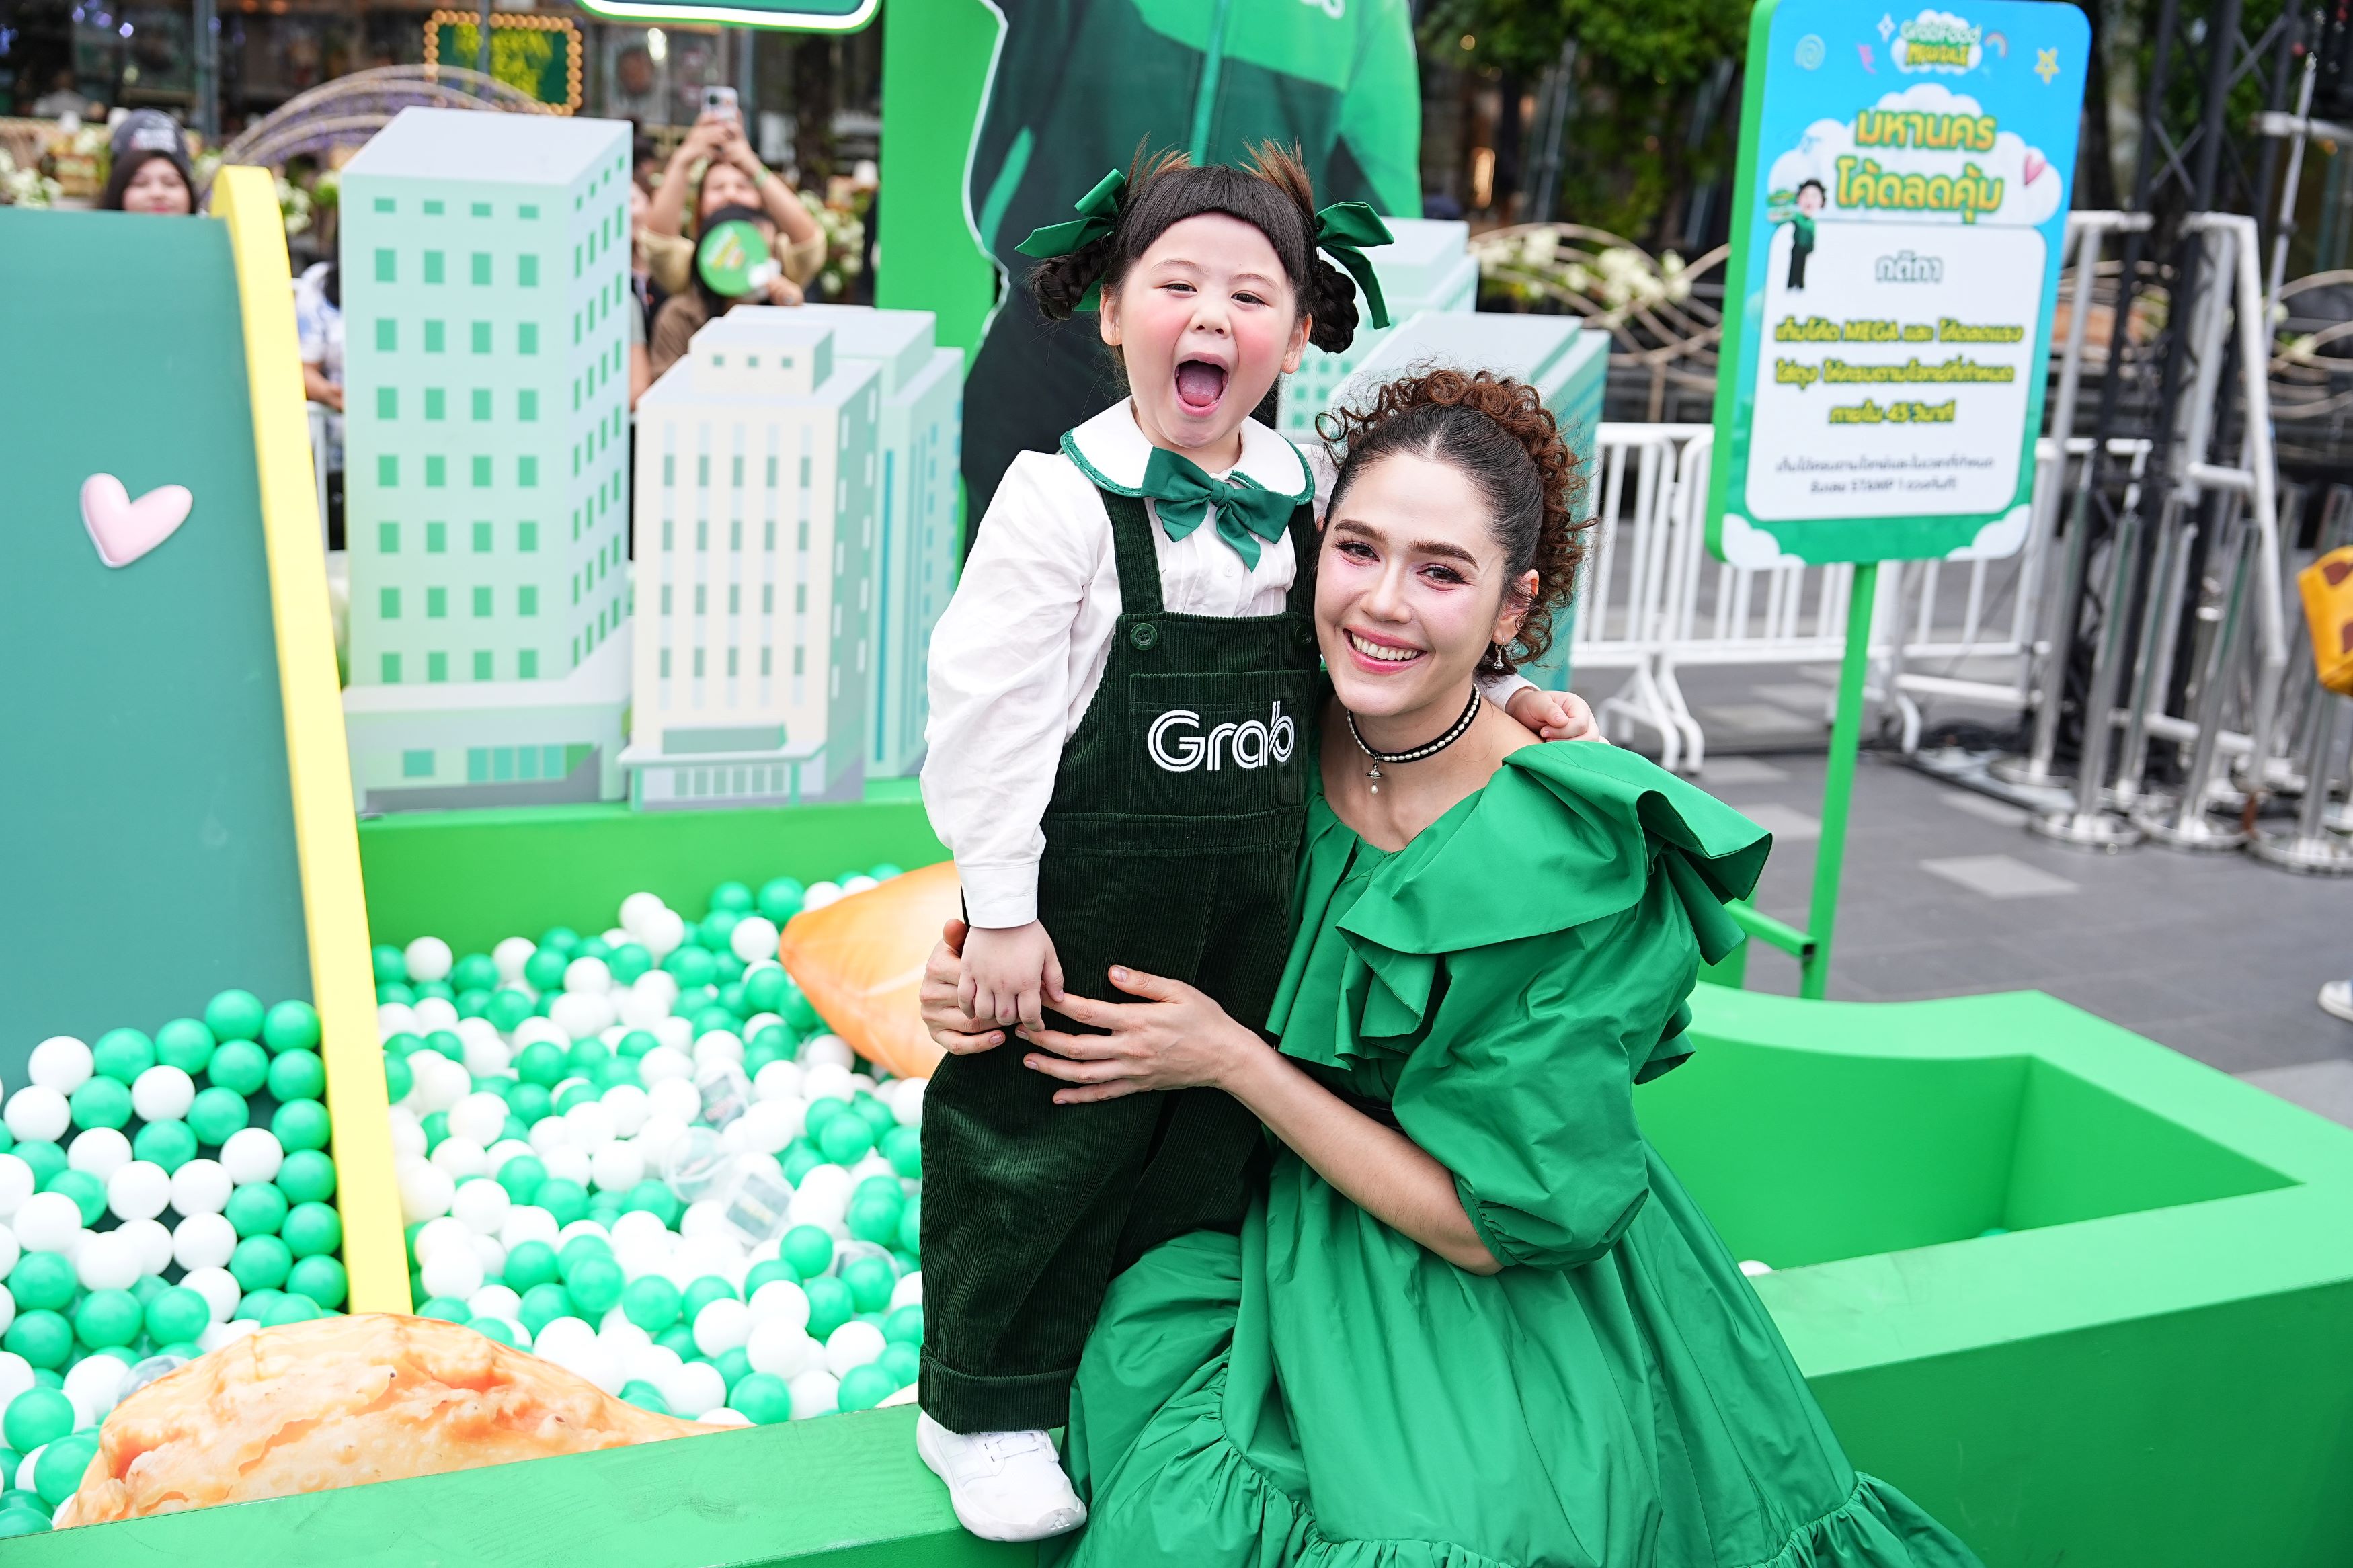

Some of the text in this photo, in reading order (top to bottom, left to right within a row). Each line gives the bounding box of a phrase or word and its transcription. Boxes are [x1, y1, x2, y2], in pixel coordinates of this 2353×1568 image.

[1856, 110, 1997, 151] มหานคร
[1836, 155, 2003, 224] โค้ดลดคุ้ม
[1875, 249, 1944, 282] กติกา
[1844, 320, 1899, 342] MEGA
[1148, 700, 1295, 772] Grab
